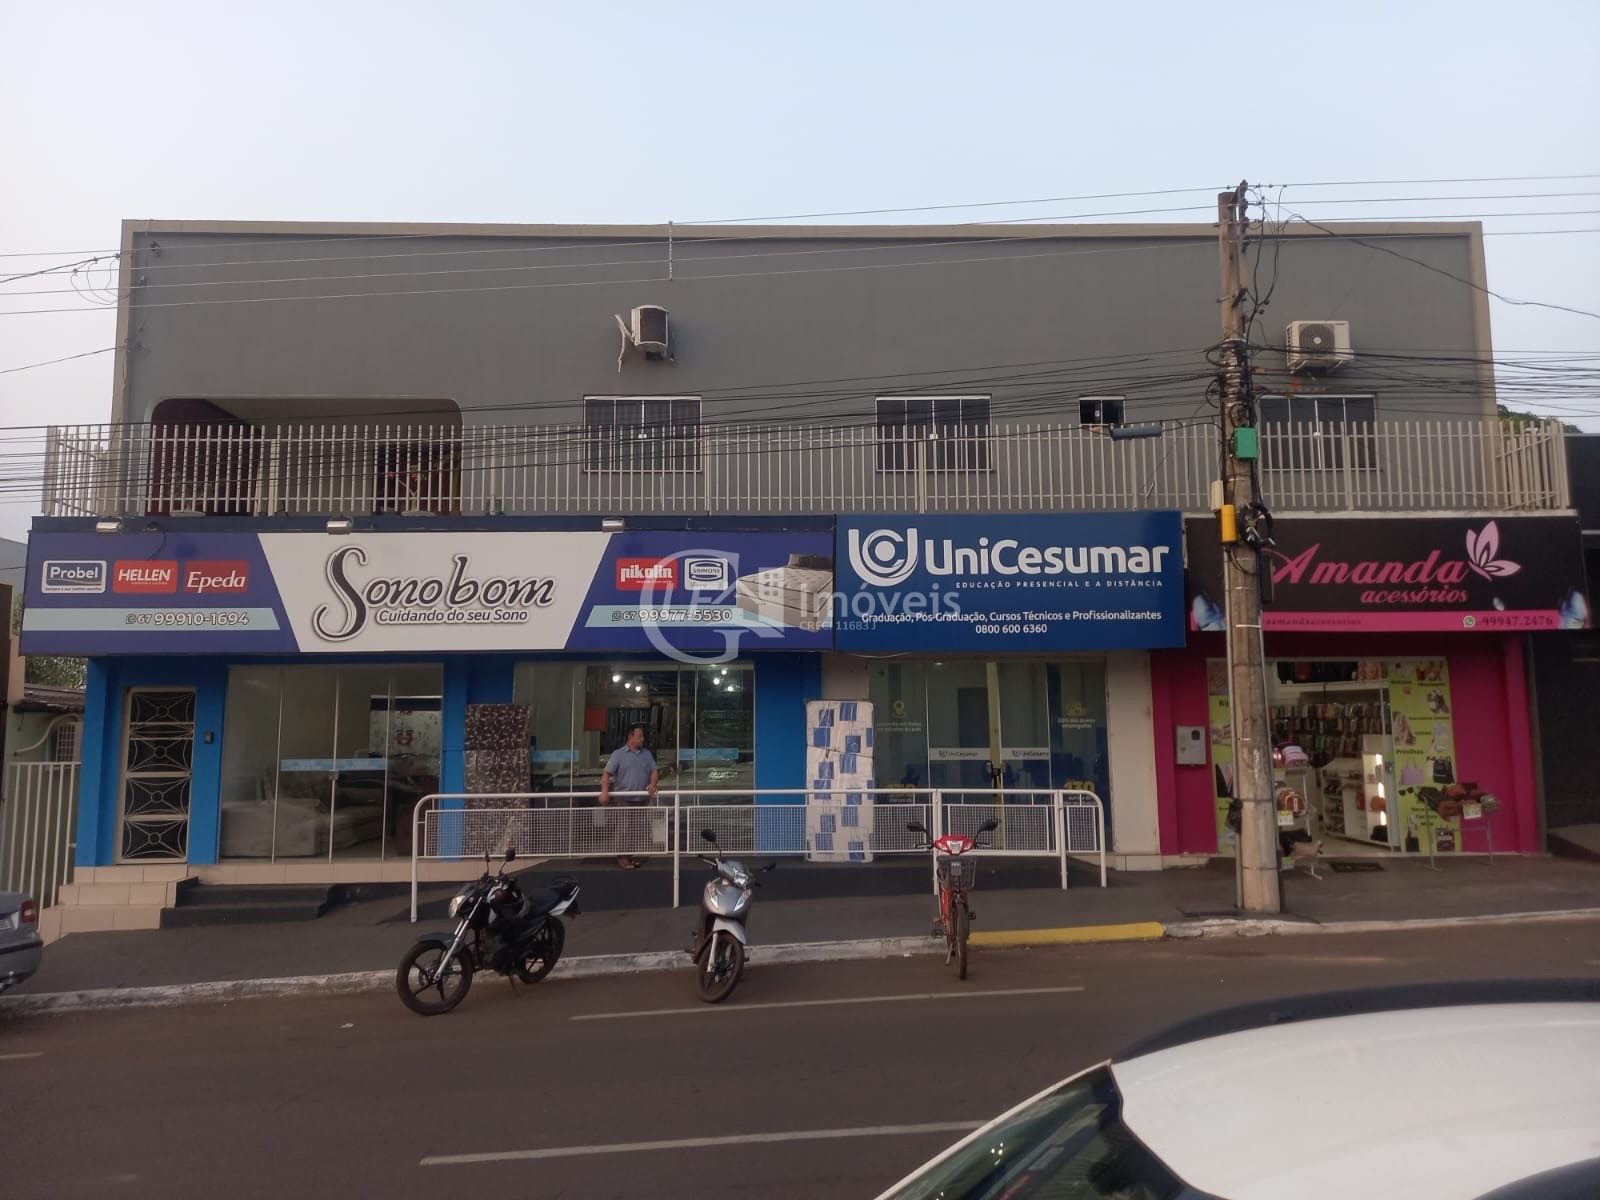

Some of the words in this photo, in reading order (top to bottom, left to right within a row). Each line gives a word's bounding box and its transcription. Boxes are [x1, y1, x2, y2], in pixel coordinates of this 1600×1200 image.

[925, 537, 1170, 575] UniCesumar
[1261, 542, 1469, 584] Amanda
[50, 566, 98, 579] Probel
[118, 568, 171, 582] HELLEN
[187, 570, 246, 593] Epeda
[956, 580, 1011, 589] EDUCAÇÃO
[1016, 580, 1080, 588] PRESENCIAL
[1106, 579, 1163, 587] DISTÂNCIA
[313, 546, 555, 640] Sonobom
[1361, 584, 1469, 603] acessórios
[138, 614, 151, 624] 67
[154, 613, 249, 626] 99910-1694
[379, 609, 444, 622] Cuidando
[447, 609, 464, 621] do
[467, 611, 490, 621] seu
[493, 609, 528, 621] Sono
[623, 611, 636, 621] 67
[639, 609, 732, 622] 99977-5530
[862, 612, 914, 624] Graduação,
[916, 611, 988, 623] Pós-Graduação,
[990, 611, 1021, 621] Cursos
[1023, 610, 1063, 621] Técnicos
[1065, 612, 1070, 620] e
[1073, 610, 1162, 620] Profissionalizantes
[976, 624, 1000, 633] 0800
[1003, 624, 1020, 633] 600
[1023, 624, 1048, 633] 6360
